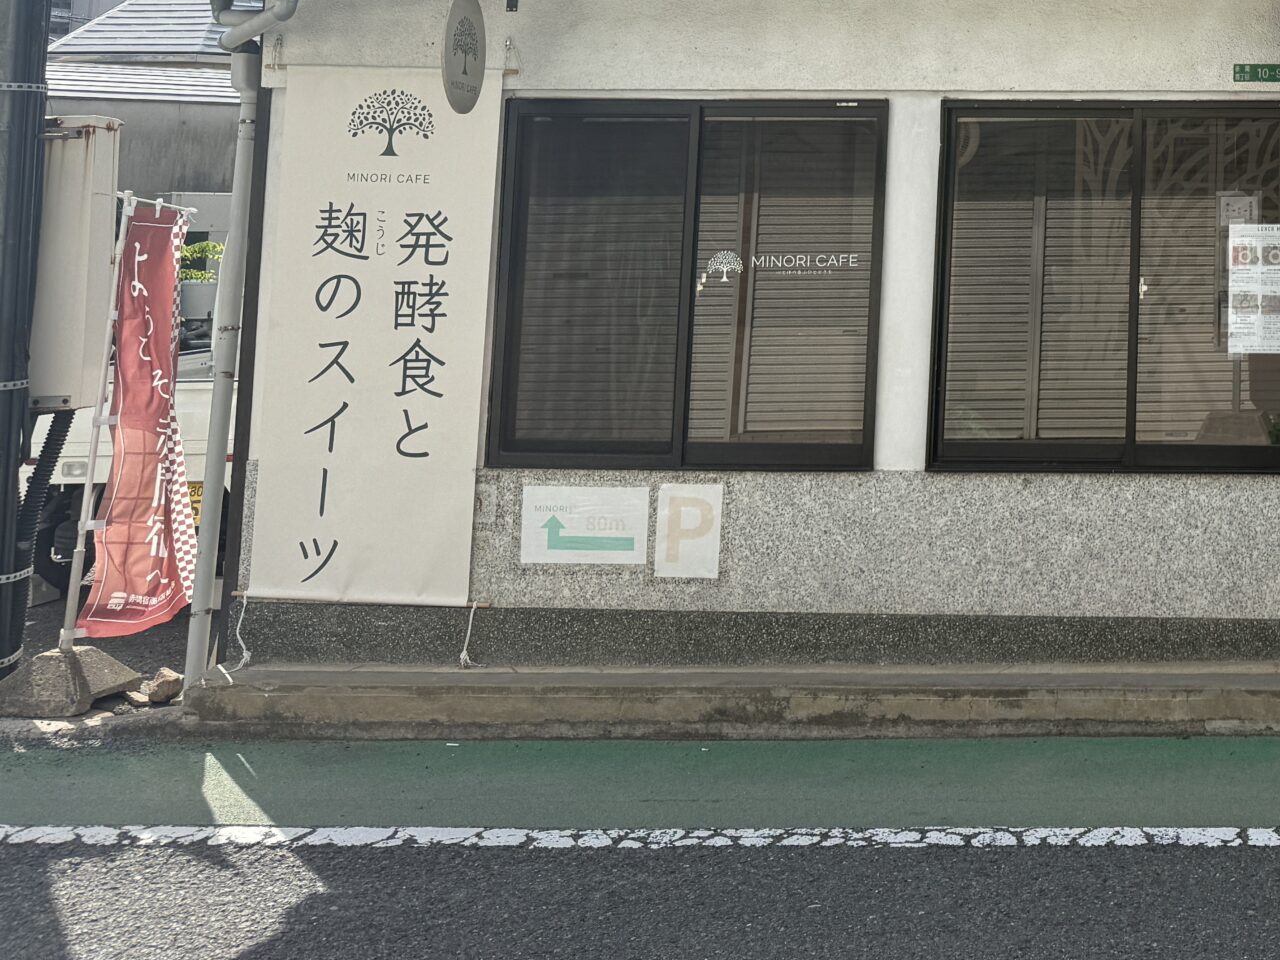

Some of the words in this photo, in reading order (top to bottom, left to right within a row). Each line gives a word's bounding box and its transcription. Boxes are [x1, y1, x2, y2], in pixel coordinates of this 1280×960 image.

[347, 172, 392, 183] MINORI
[396, 173, 431, 184] CAFE
[375, 209, 386, 256] こうじ
[751, 255, 811, 268] MINORI
[815, 254, 859, 267] CAFE
[389, 209, 453, 458] 発酵食と
[299, 201, 370, 583] 麹のスイーツ
[534, 504, 568, 513] MINORI
[585, 516, 626, 532] 80m
[666, 496, 715, 563] P
